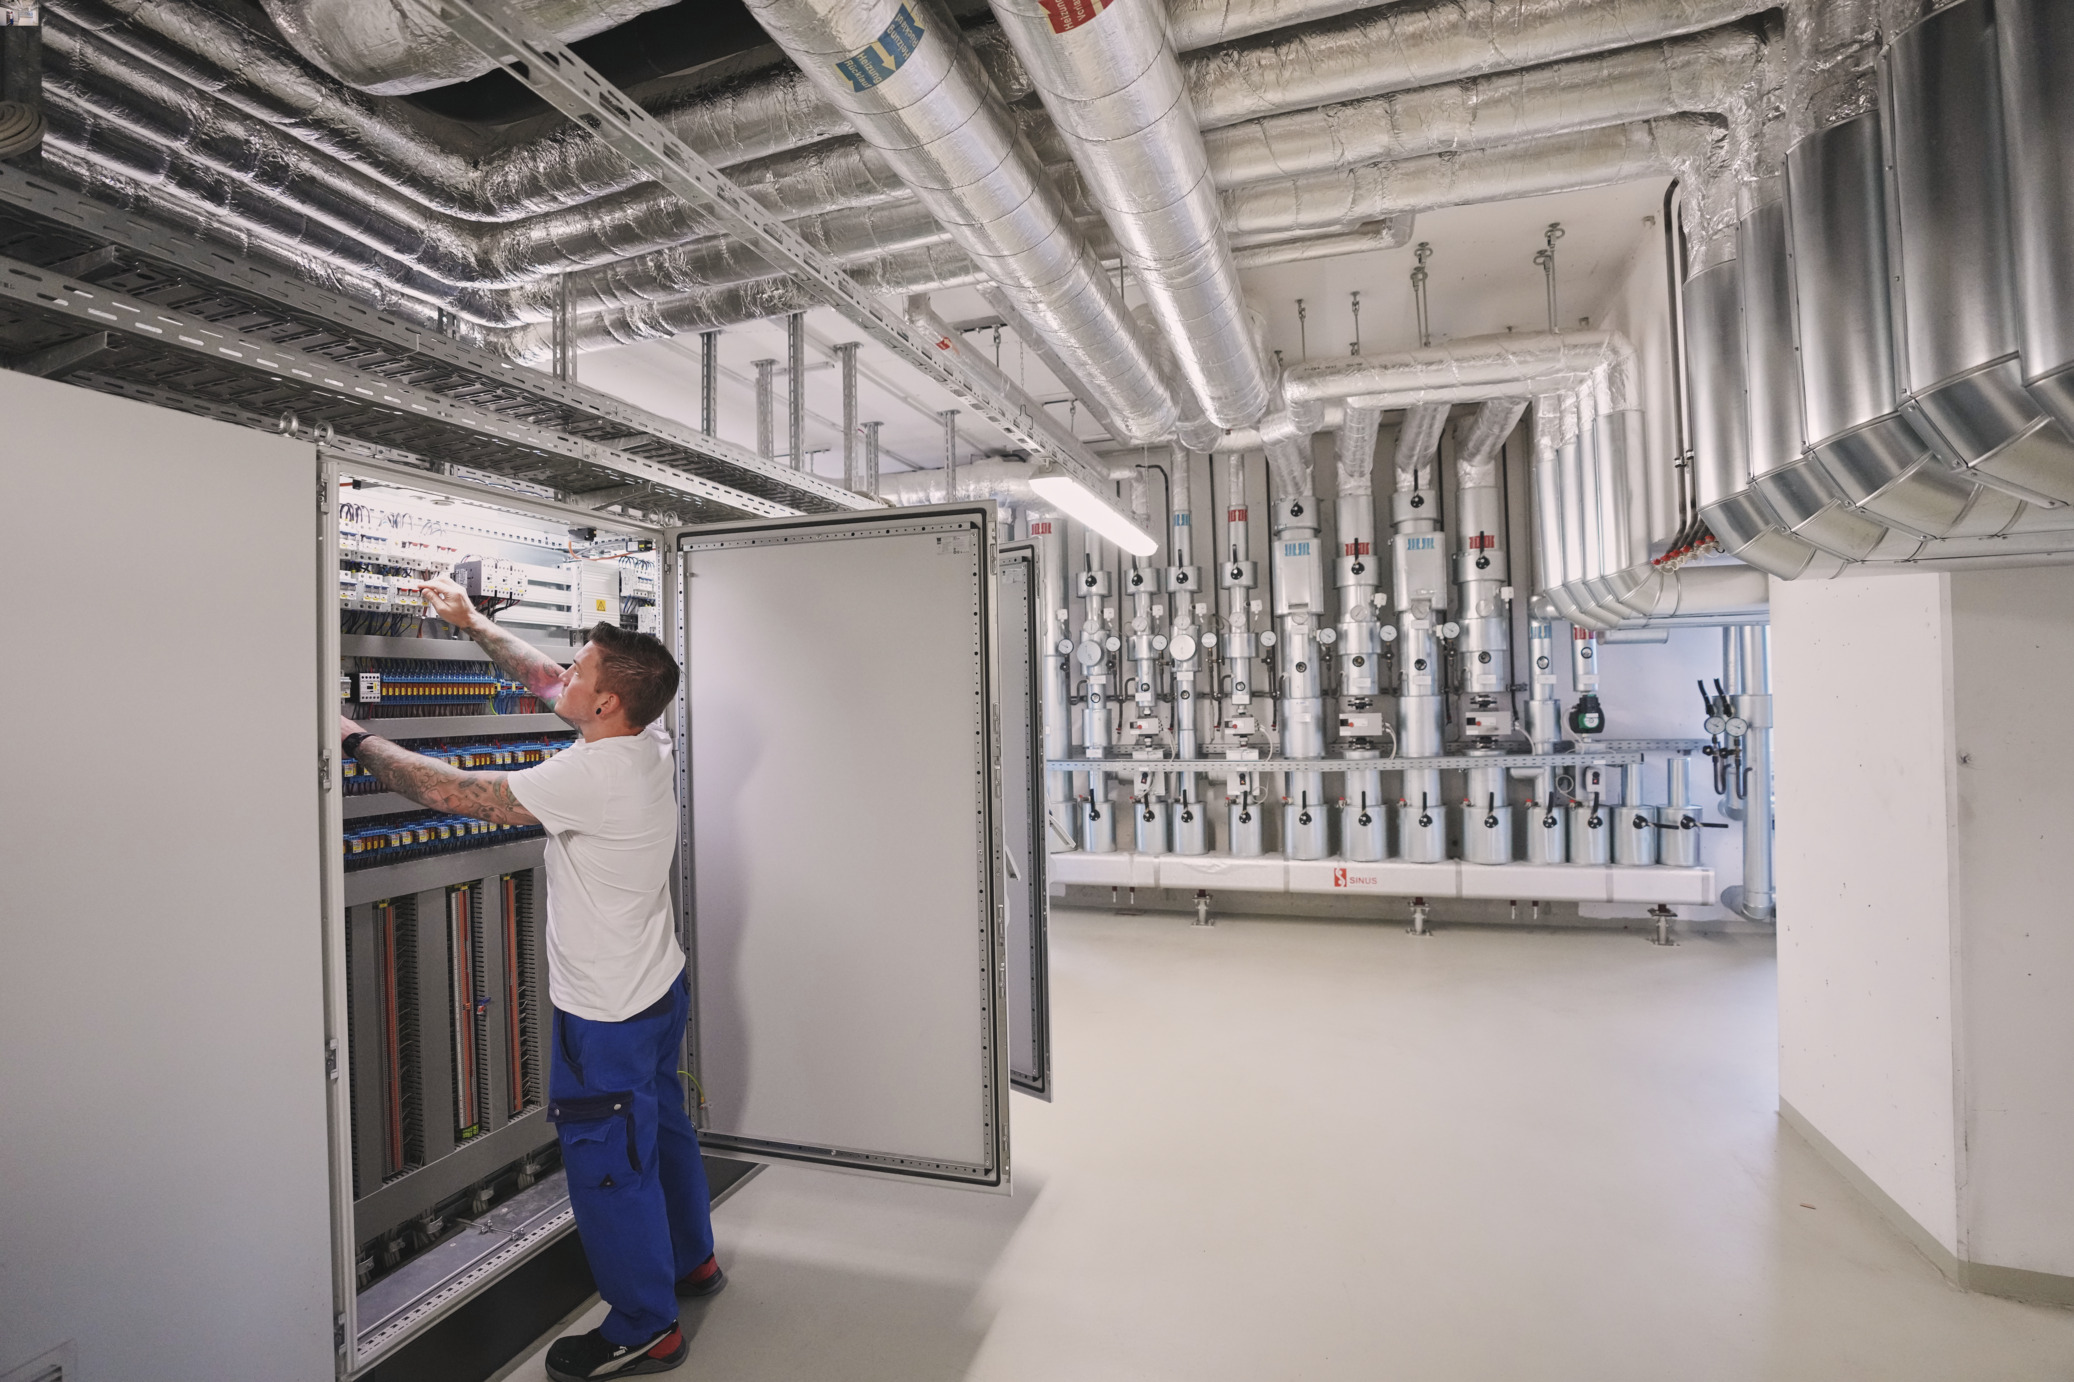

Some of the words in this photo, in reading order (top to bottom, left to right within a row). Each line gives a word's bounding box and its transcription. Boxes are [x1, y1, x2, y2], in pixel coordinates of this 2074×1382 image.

[1072, 0, 1086, 21] Vorla
[887, 24, 911, 60] Heizung
[894, 13, 919, 48] Rücklauf
[843, 60, 873, 88] Rücklauf
[856, 52, 883, 84] Heizung
[1349, 877, 1378, 885] SINUS
